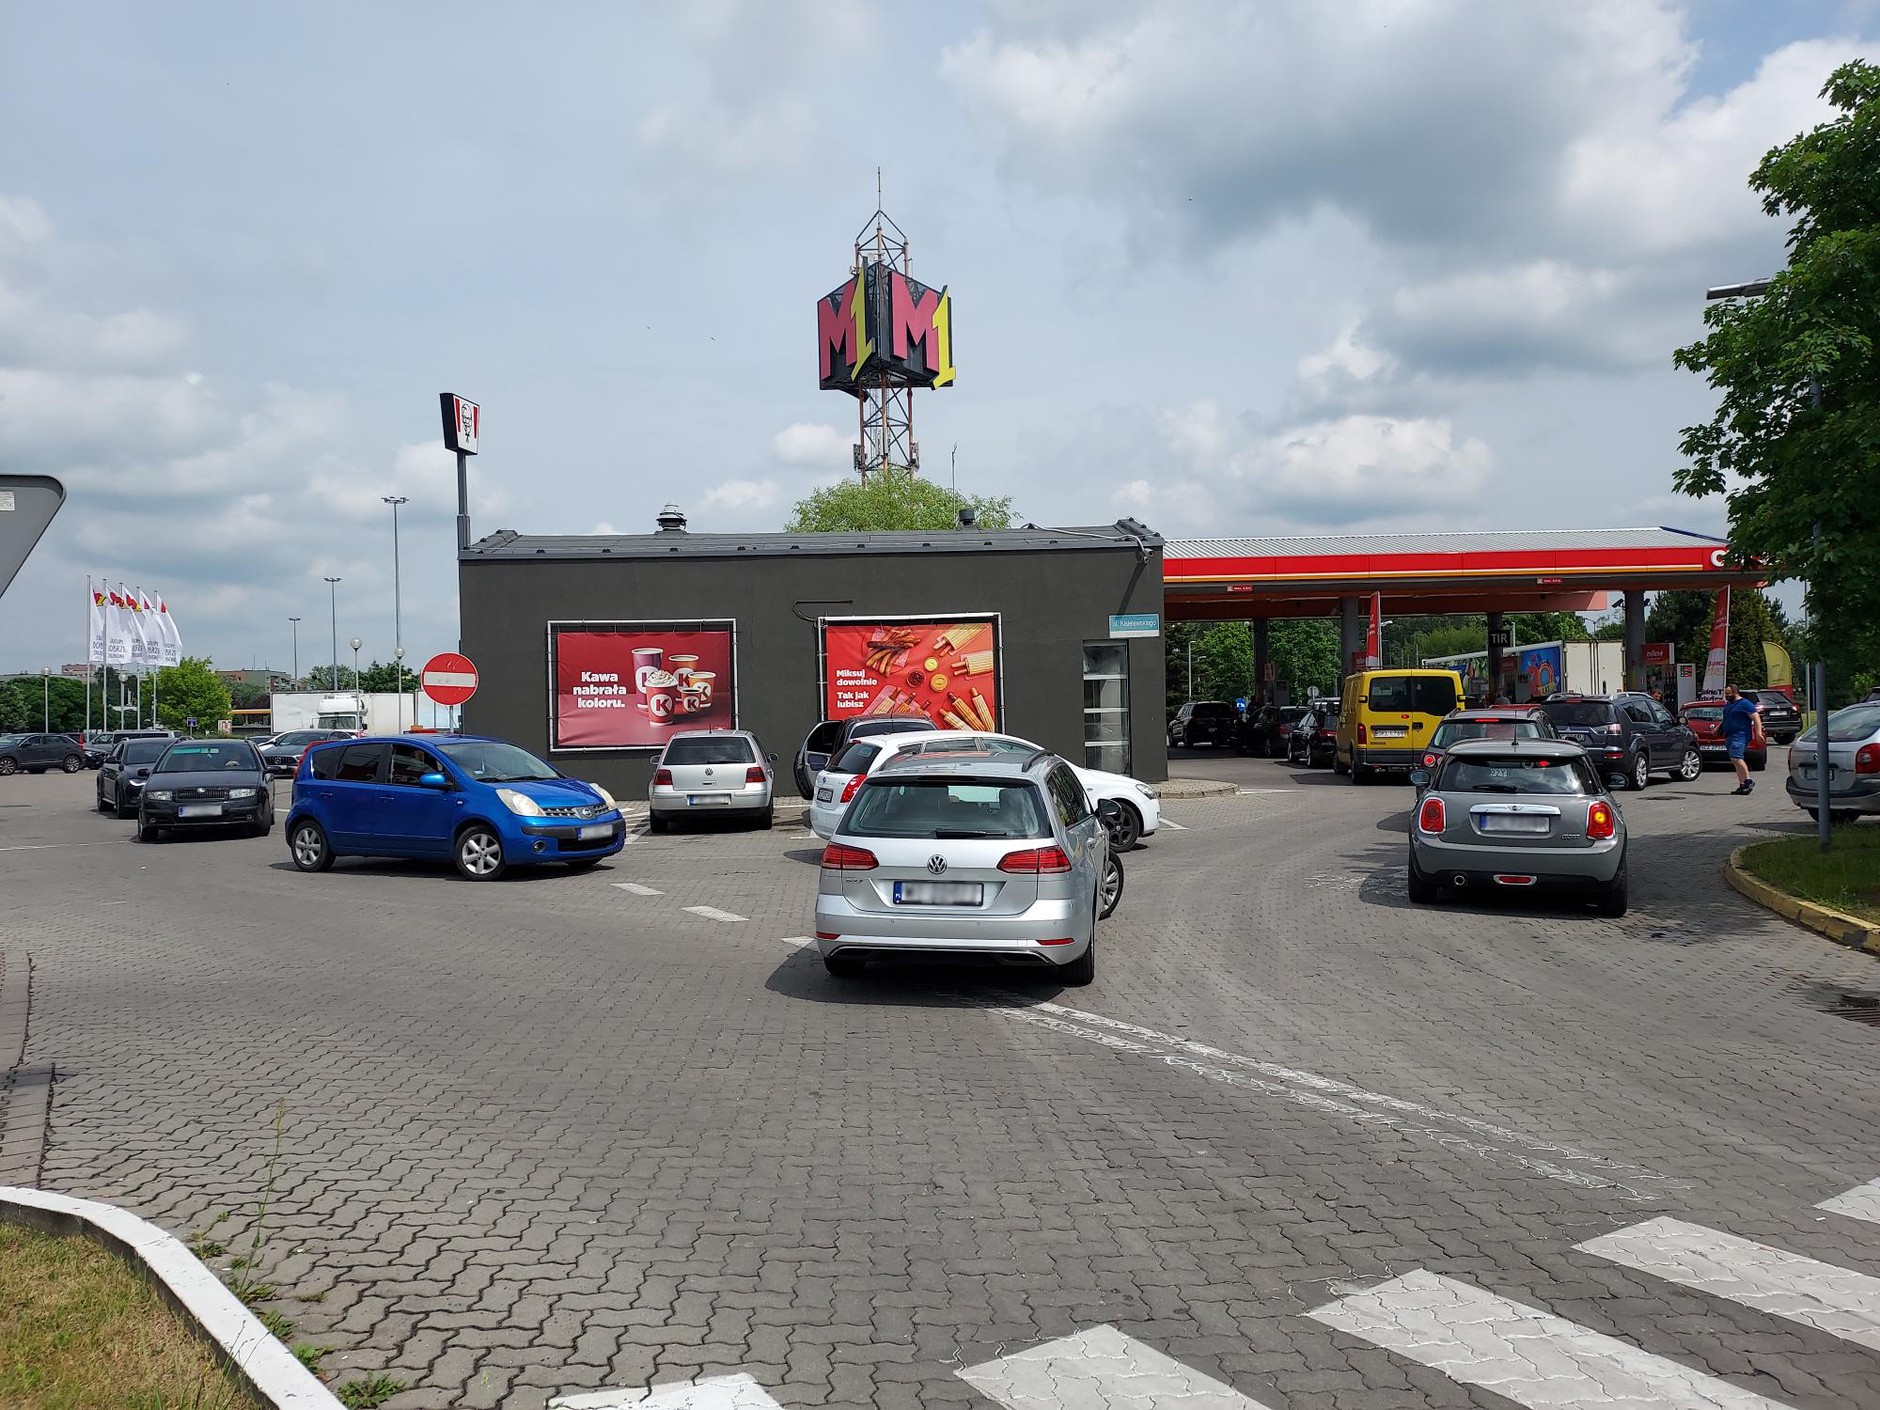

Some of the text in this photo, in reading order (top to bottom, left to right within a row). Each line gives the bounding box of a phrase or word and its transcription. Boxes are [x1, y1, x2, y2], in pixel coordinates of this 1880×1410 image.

[819, 260, 873, 382] M1
[891, 271, 957, 390] M1
[1491, 633, 1508, 644] TIR
[581, 671, 618, 683] Kawa
[836, 669, 866, 679] Miksuj
[836, 678, 878, 686] dowolnie
[572, 683, 627, 696] nabrała
[837, 691, 869, 700] Tak jak
[577, 697, 626, 709] koloru.
[837, 700, 864, 708] lubisz
